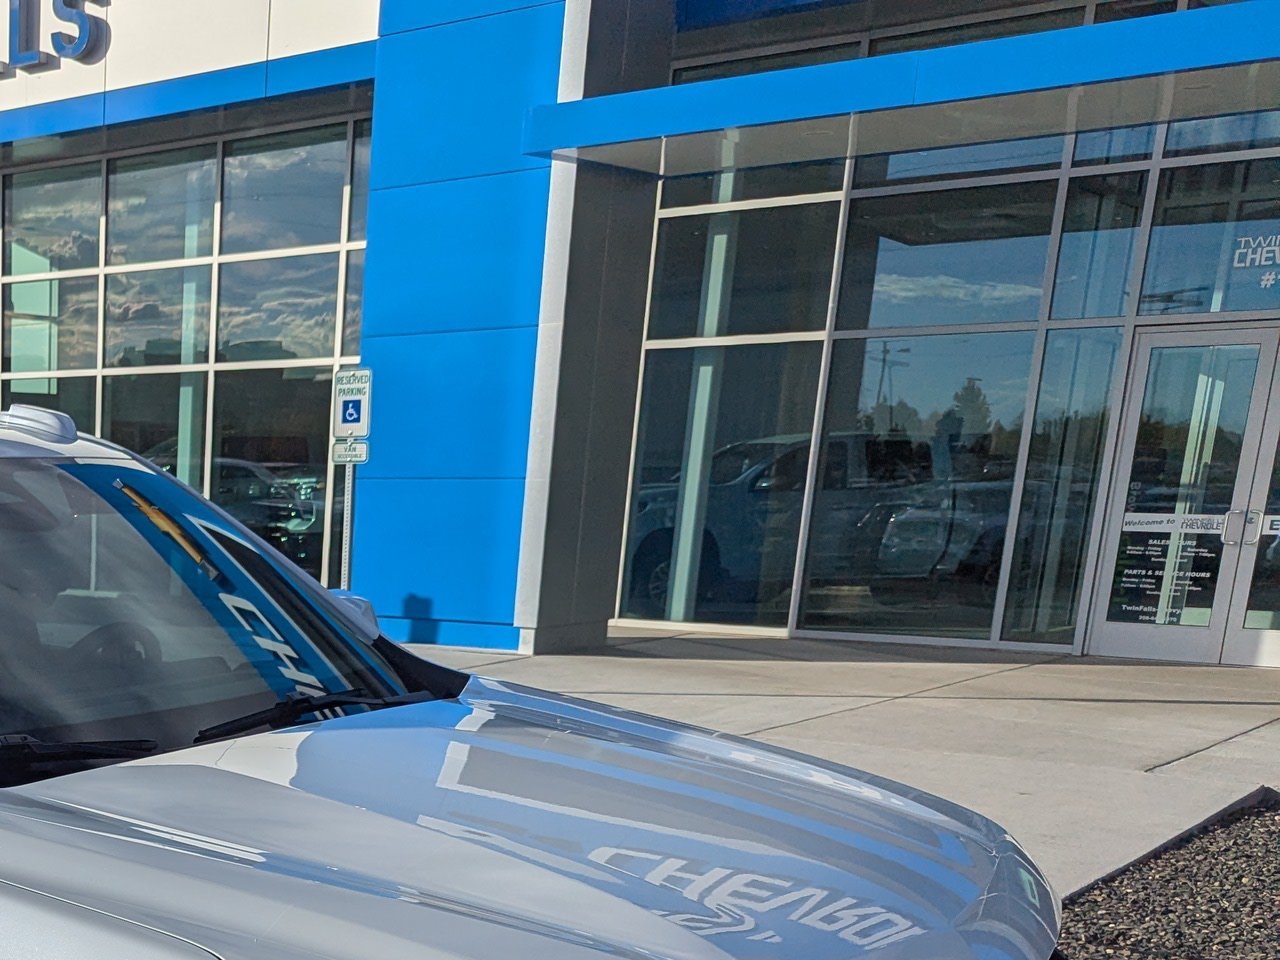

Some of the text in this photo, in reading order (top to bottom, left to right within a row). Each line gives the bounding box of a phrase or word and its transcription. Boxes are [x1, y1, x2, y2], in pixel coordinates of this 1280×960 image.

[337, 375, 368, 385] RESERVED
[338, 387, 366, 397] PARKING
[1124, 519, 1164, 527] Welcome
